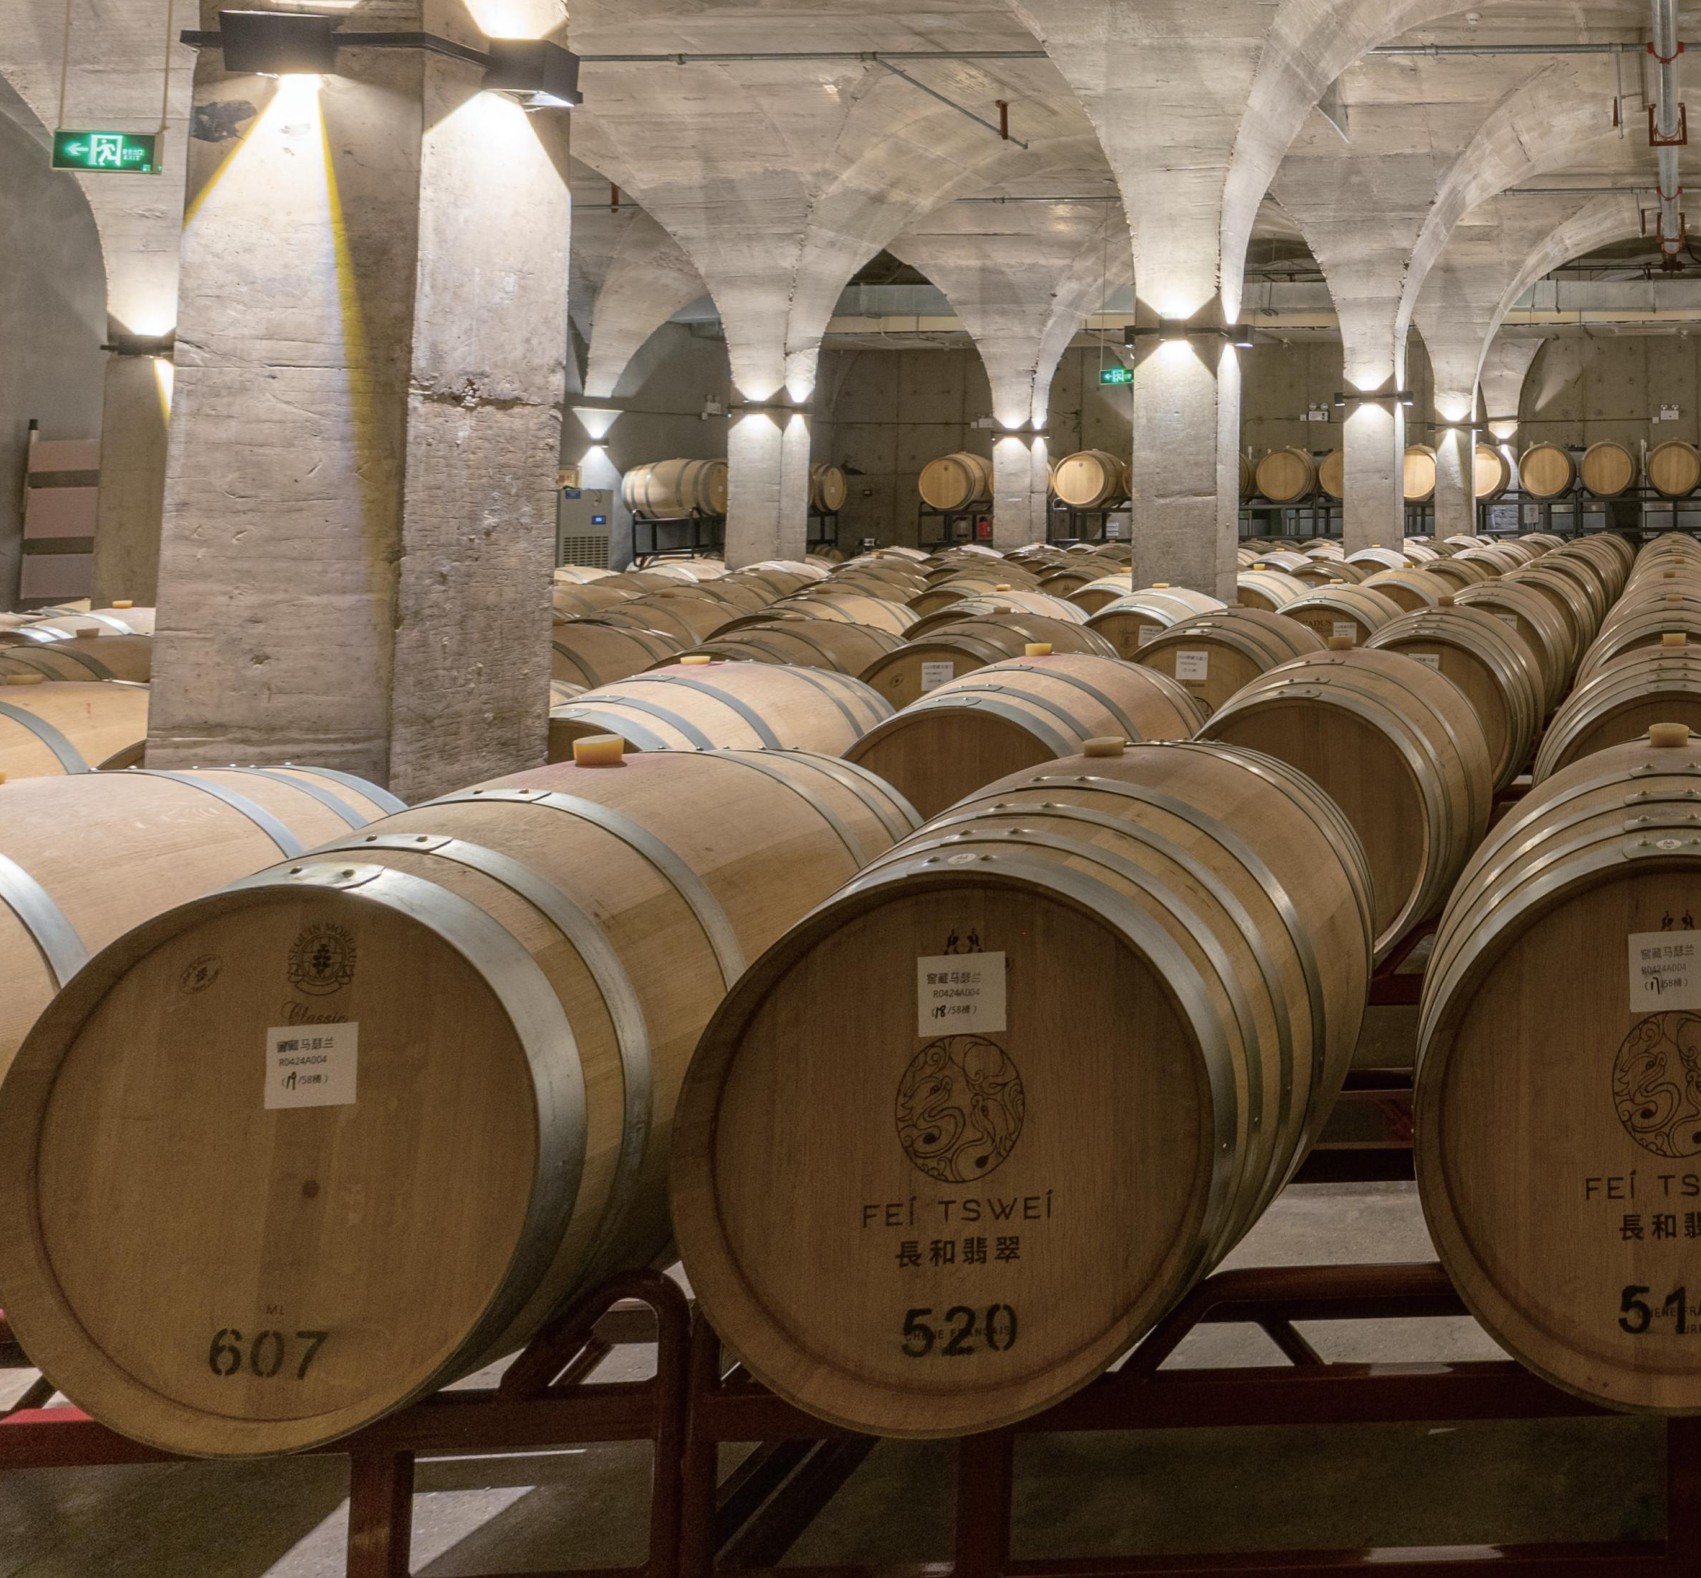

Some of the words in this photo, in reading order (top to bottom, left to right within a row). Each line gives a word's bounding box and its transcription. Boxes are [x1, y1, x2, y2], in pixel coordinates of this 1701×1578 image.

[280, 1000, 349, 1025] Classic
[895, 1236, 1021, 1268] 長和翡翠
[902, 1303, 1018, 1358] 520
[209, 1327, 329, 1380] 607
